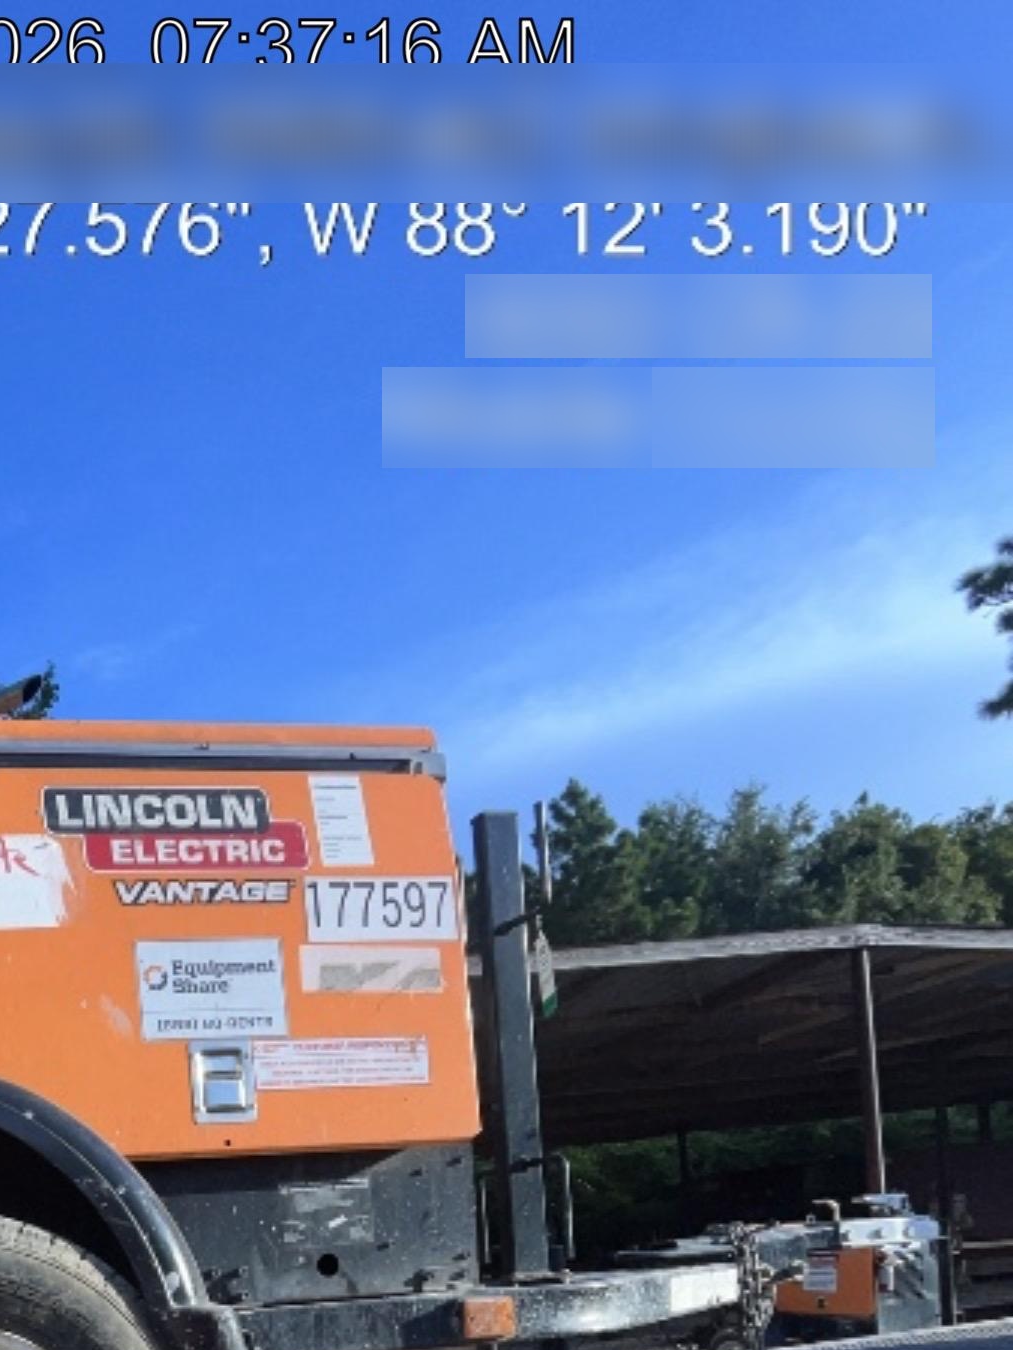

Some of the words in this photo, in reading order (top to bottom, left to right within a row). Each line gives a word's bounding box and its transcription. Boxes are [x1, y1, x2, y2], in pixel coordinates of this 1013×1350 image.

[55, 794, 258, 829] LINCOLN
[109, 838, 286, 865] ELECTRIC
[114, 878, 294, 905] VANTAGE
[307, 881, 448, 928] 177597
[172, 959, 276, 977] Equipment
[172, 979, 229, 994] Share
